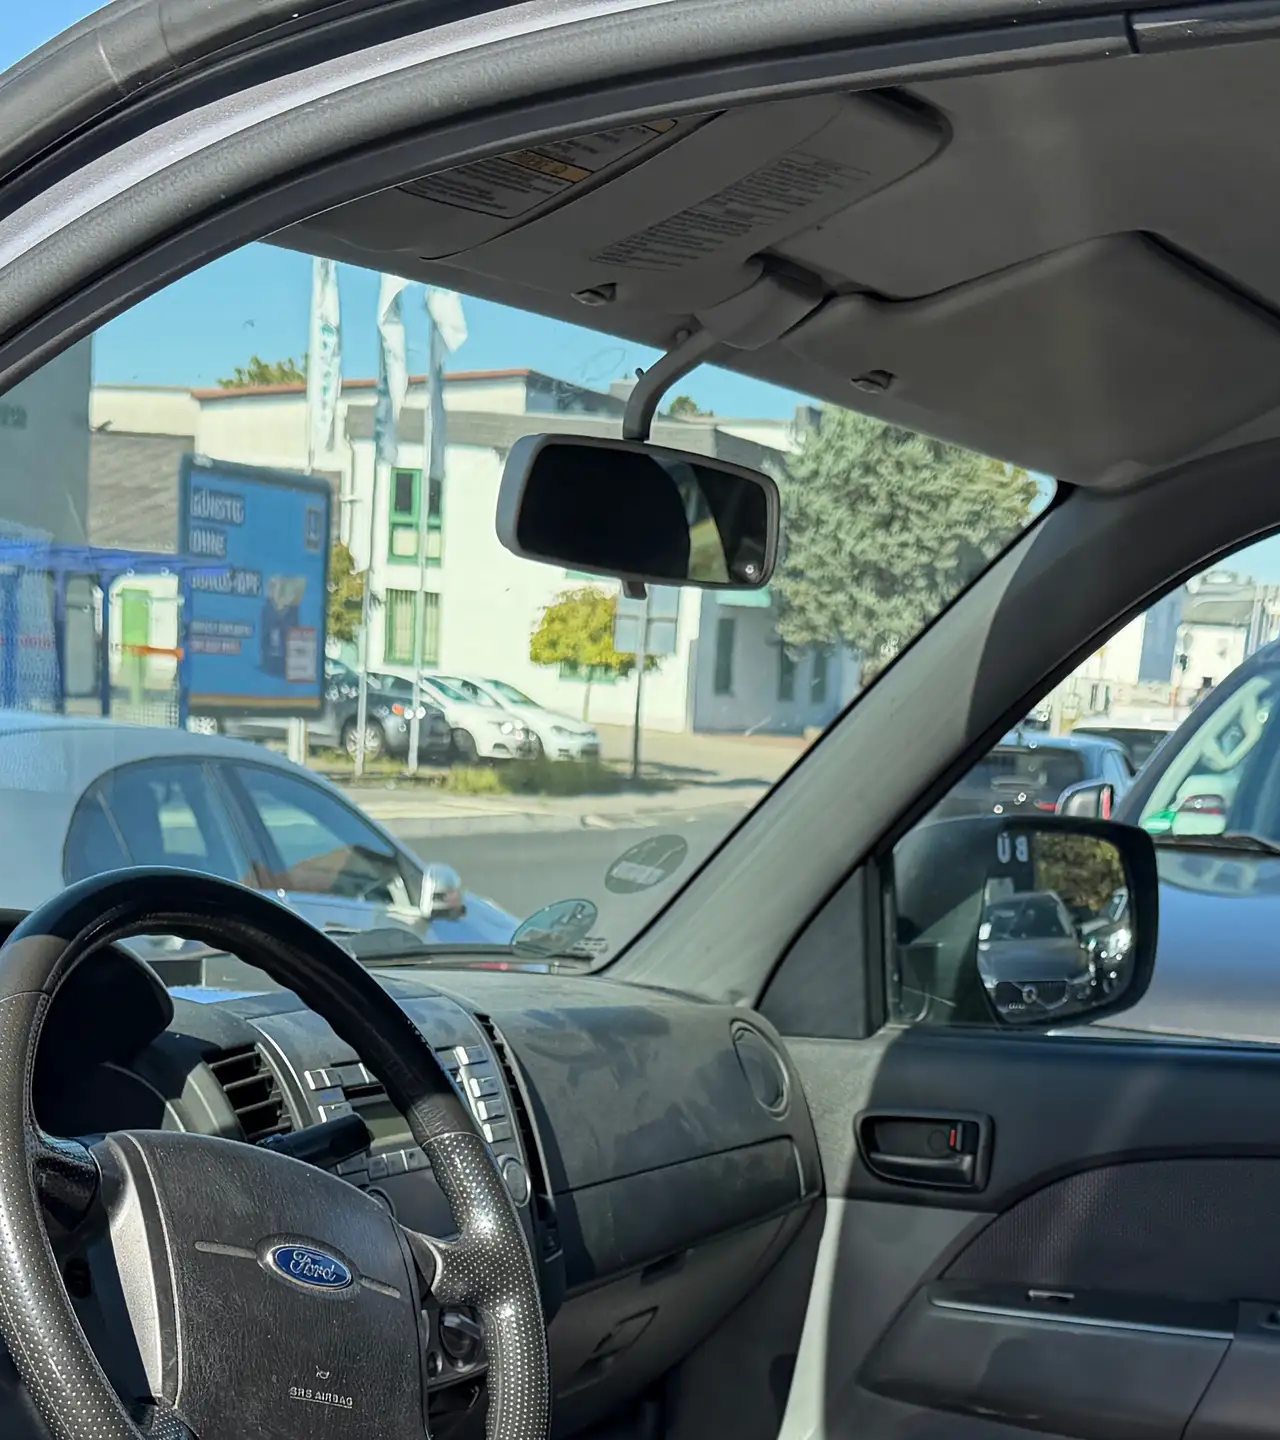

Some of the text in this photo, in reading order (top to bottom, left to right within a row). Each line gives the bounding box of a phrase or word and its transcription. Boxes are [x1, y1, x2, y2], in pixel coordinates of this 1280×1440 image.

[289, 1249, 337, 1282] Ford
[289, 1386, 354, 1407] SRS AIRBAG
